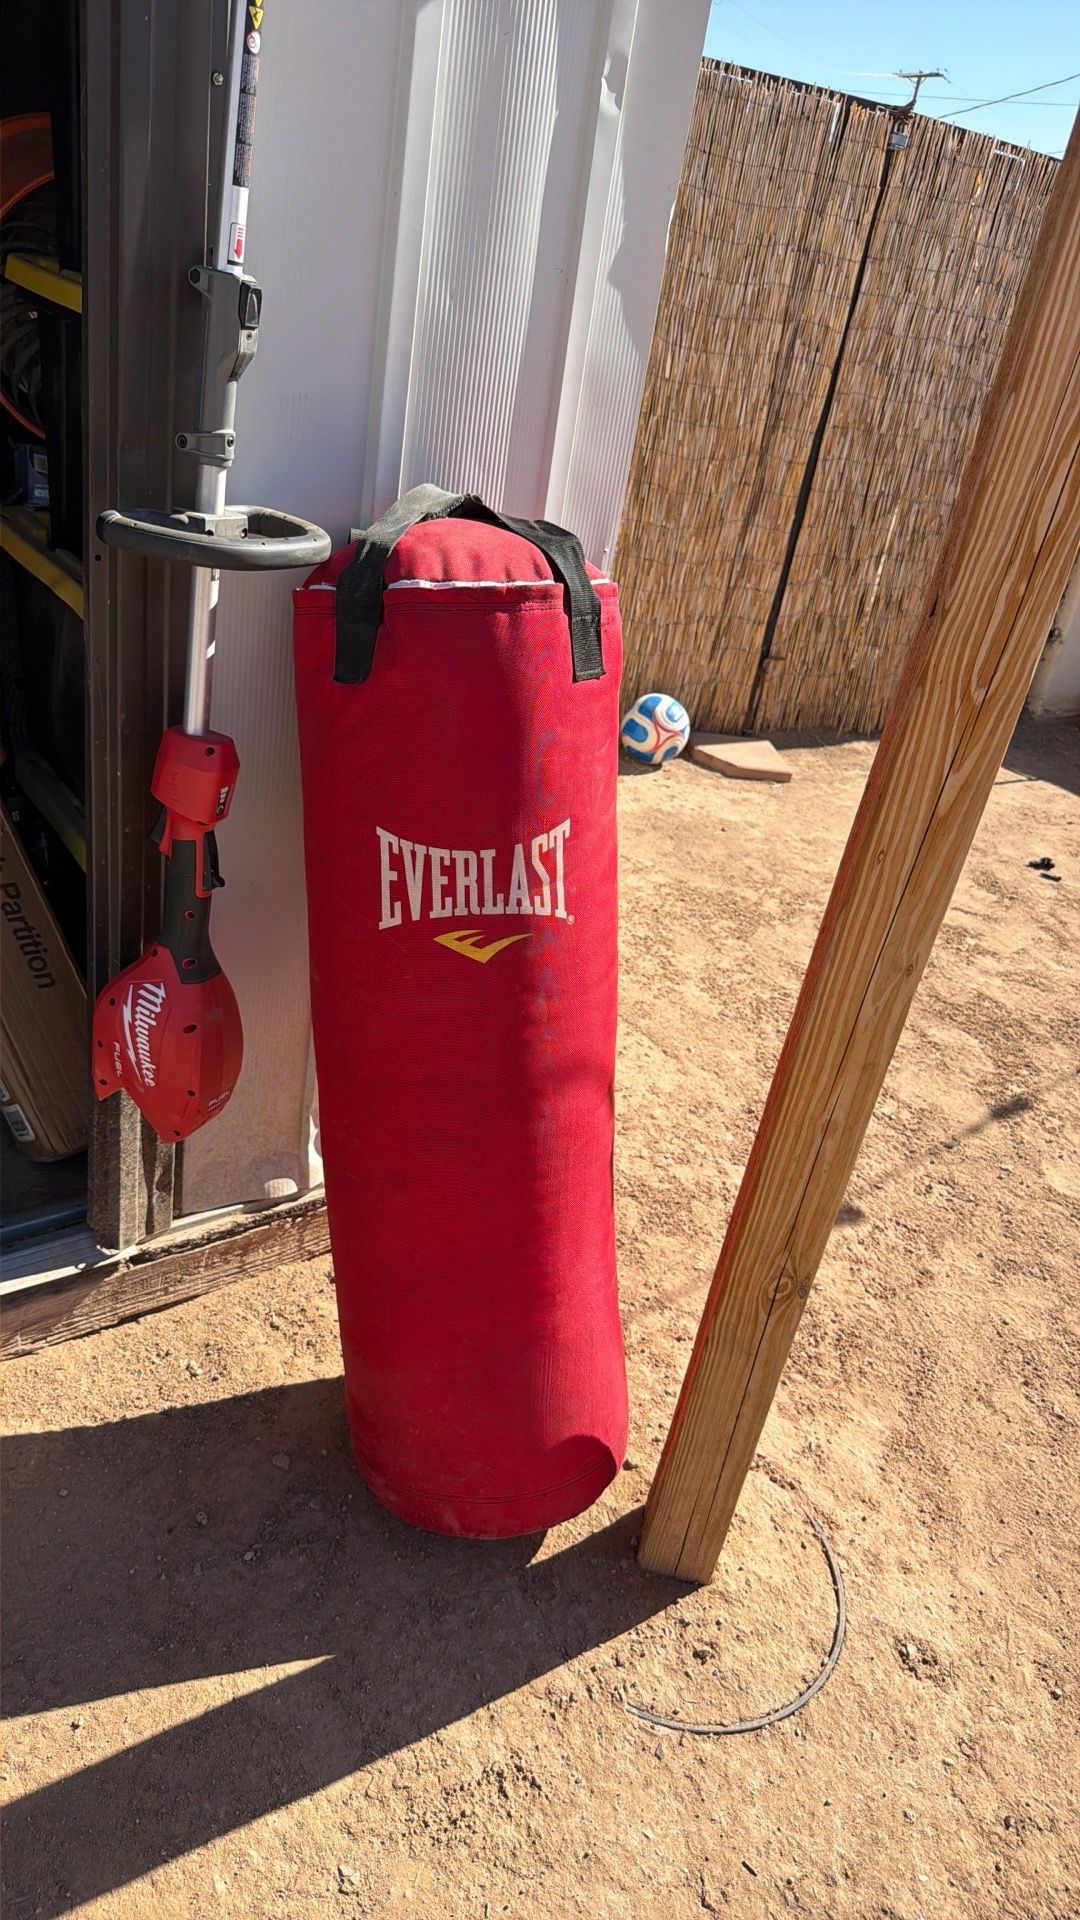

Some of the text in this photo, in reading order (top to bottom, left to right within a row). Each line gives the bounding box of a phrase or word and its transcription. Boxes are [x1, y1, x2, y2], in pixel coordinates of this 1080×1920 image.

[376, 817, 571, 930] EVERLAST
[0, 881, 57, 989] Partition
[113, 1041, 123, 1077] FUEL
[134, 981, 166, 1088] Milwaukee
